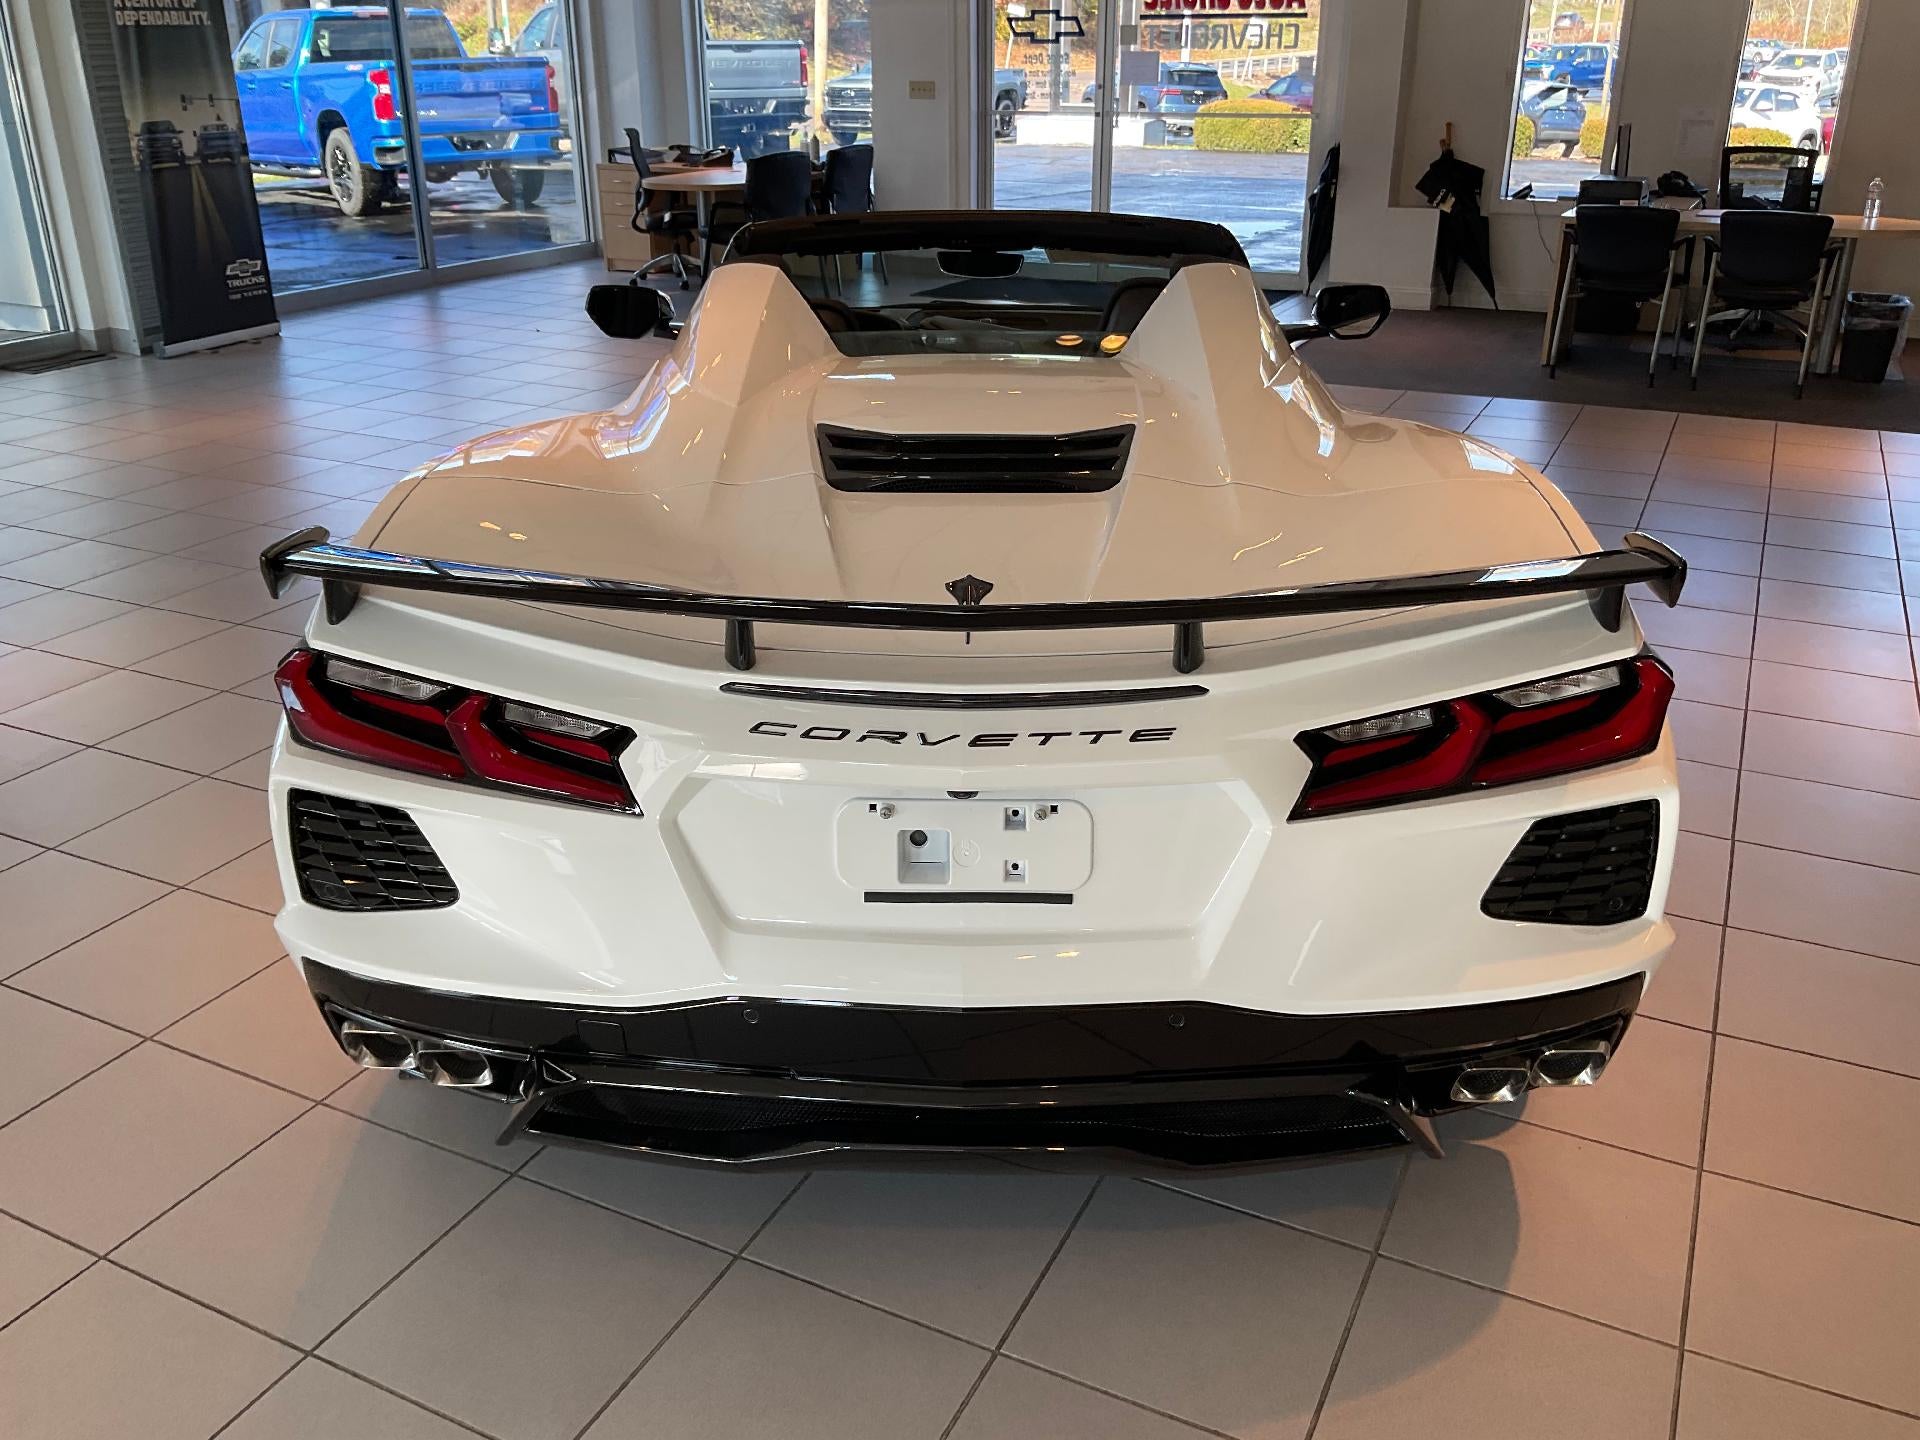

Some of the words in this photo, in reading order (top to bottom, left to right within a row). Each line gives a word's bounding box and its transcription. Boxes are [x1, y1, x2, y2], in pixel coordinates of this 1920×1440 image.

[115, 10, 211, 26] DEPENDABILITY.
[226, 275, 266, 288] TRUCKS
[748, 721, 1178, 748] CORVETTE
